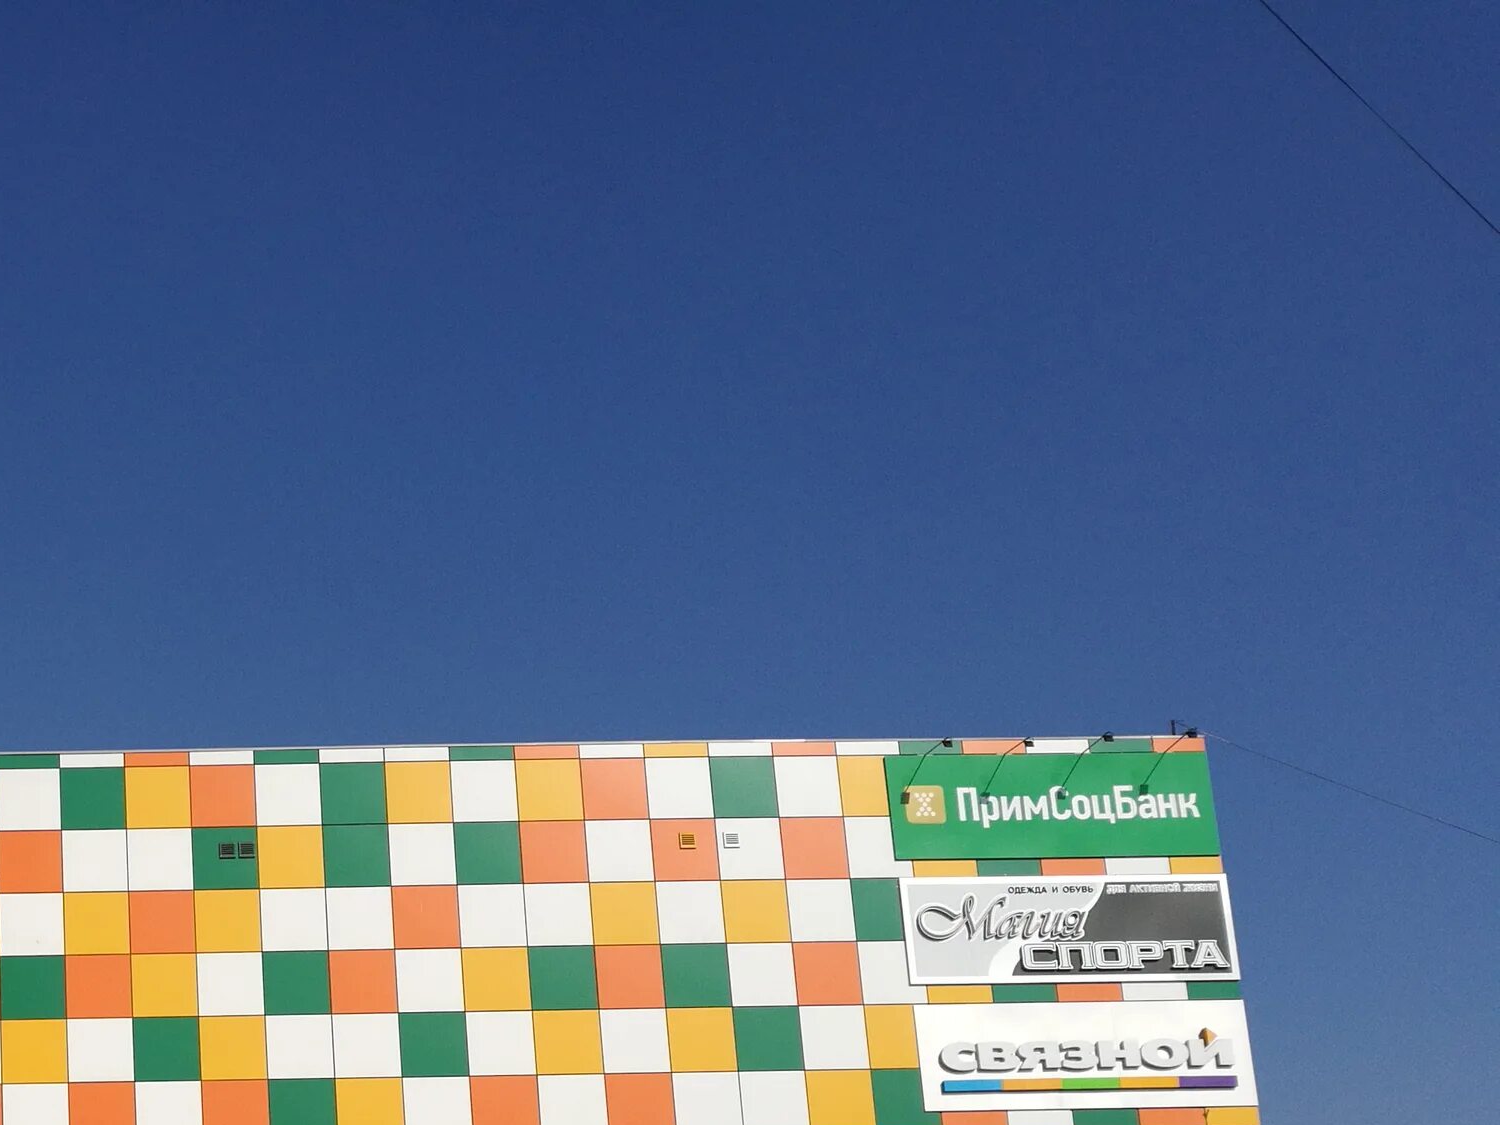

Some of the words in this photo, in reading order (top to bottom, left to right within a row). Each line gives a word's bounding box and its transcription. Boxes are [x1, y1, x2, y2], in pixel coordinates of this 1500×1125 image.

[956, 784, 1201, 828] ПримСоцБанк
[1007, 885, 1048, 895] ОДЕЖДА
[1051, 885, 1059, 894] И
[1062, 885, 1095, 894] ОБУВЬ
[916, 894, 1086, 941] Магия
[1022, 939, 1231, 970] СПОРТА
